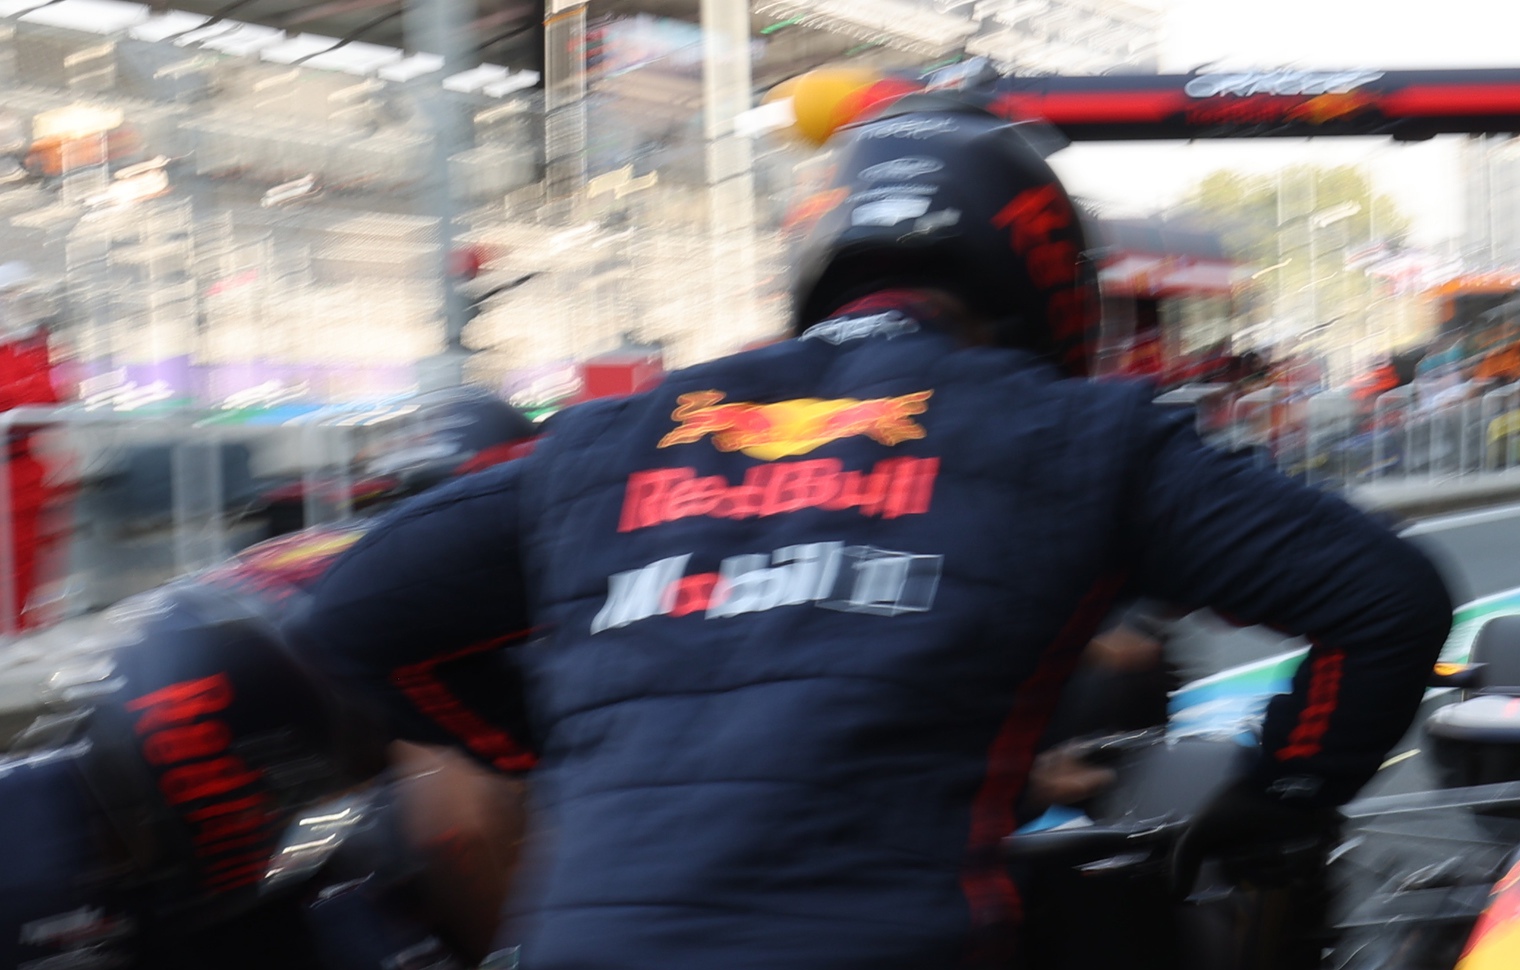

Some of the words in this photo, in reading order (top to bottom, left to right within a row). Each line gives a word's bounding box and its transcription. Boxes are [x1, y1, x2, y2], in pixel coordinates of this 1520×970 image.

[616, 463, 772, 533] Red
[760, 456, 942, 521] Bull
[590, 540, 845, 637] Mobil
